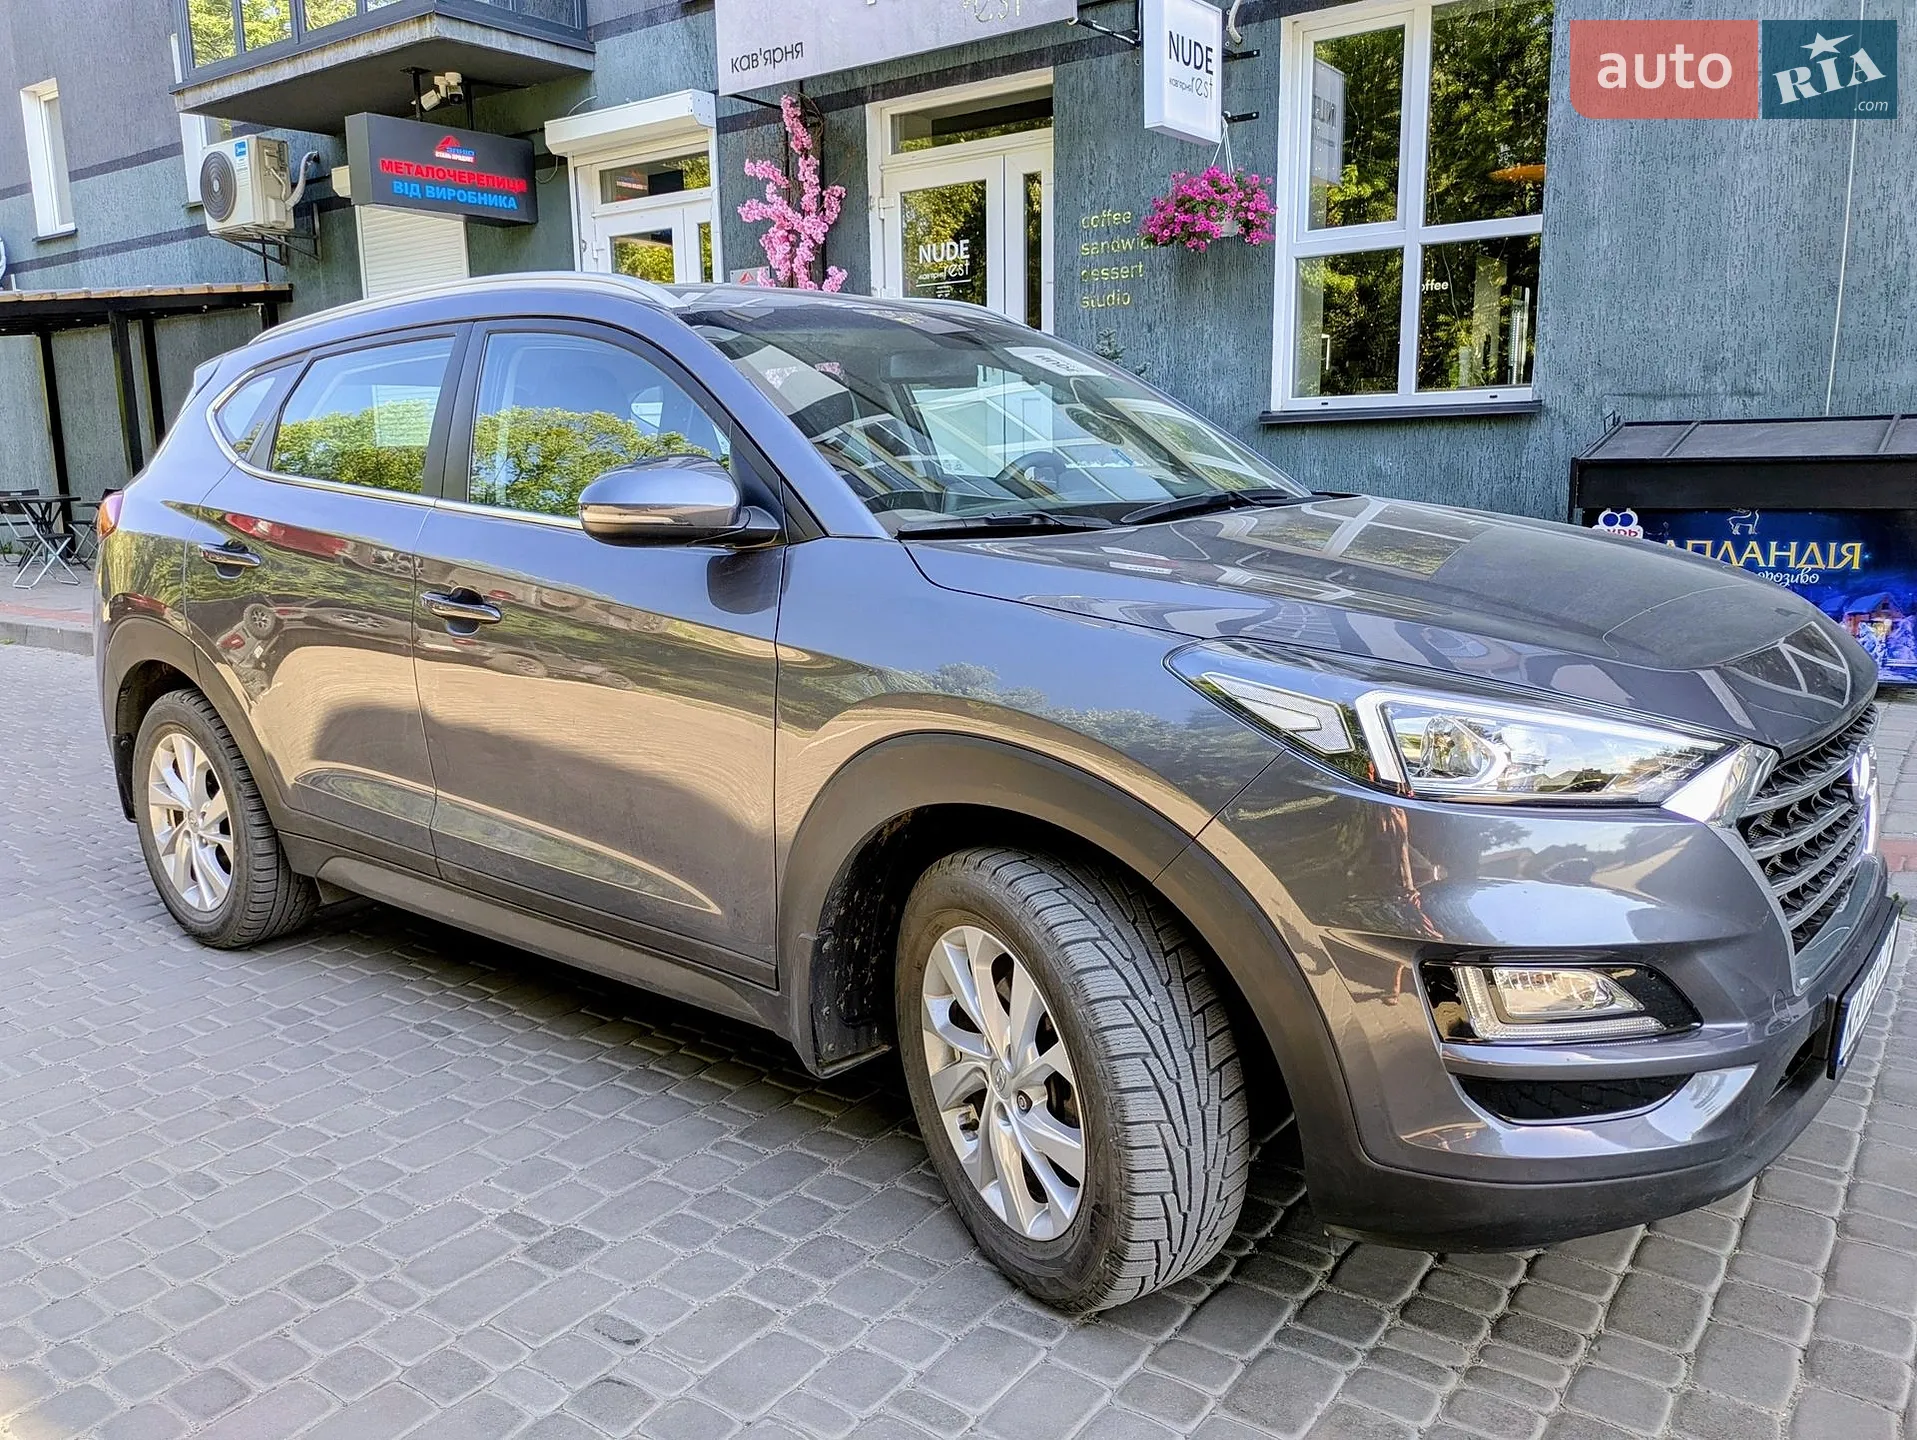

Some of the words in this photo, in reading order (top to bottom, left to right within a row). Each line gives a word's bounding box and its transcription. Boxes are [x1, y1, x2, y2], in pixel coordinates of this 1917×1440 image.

[730, 41, 804, 74] кав'ярня
[1168, 30, 1214, 76] NUDE
[1191, 76, 1213, 101] rest
[392, 180, 422, 200] ВІД
[425, 185, 518, 210] ВИРОБНИКА
[1081, 209, 1132, 229] coffee
[918, 239, 970, 264] NUDE
[943, 260, 970, 280] rest
